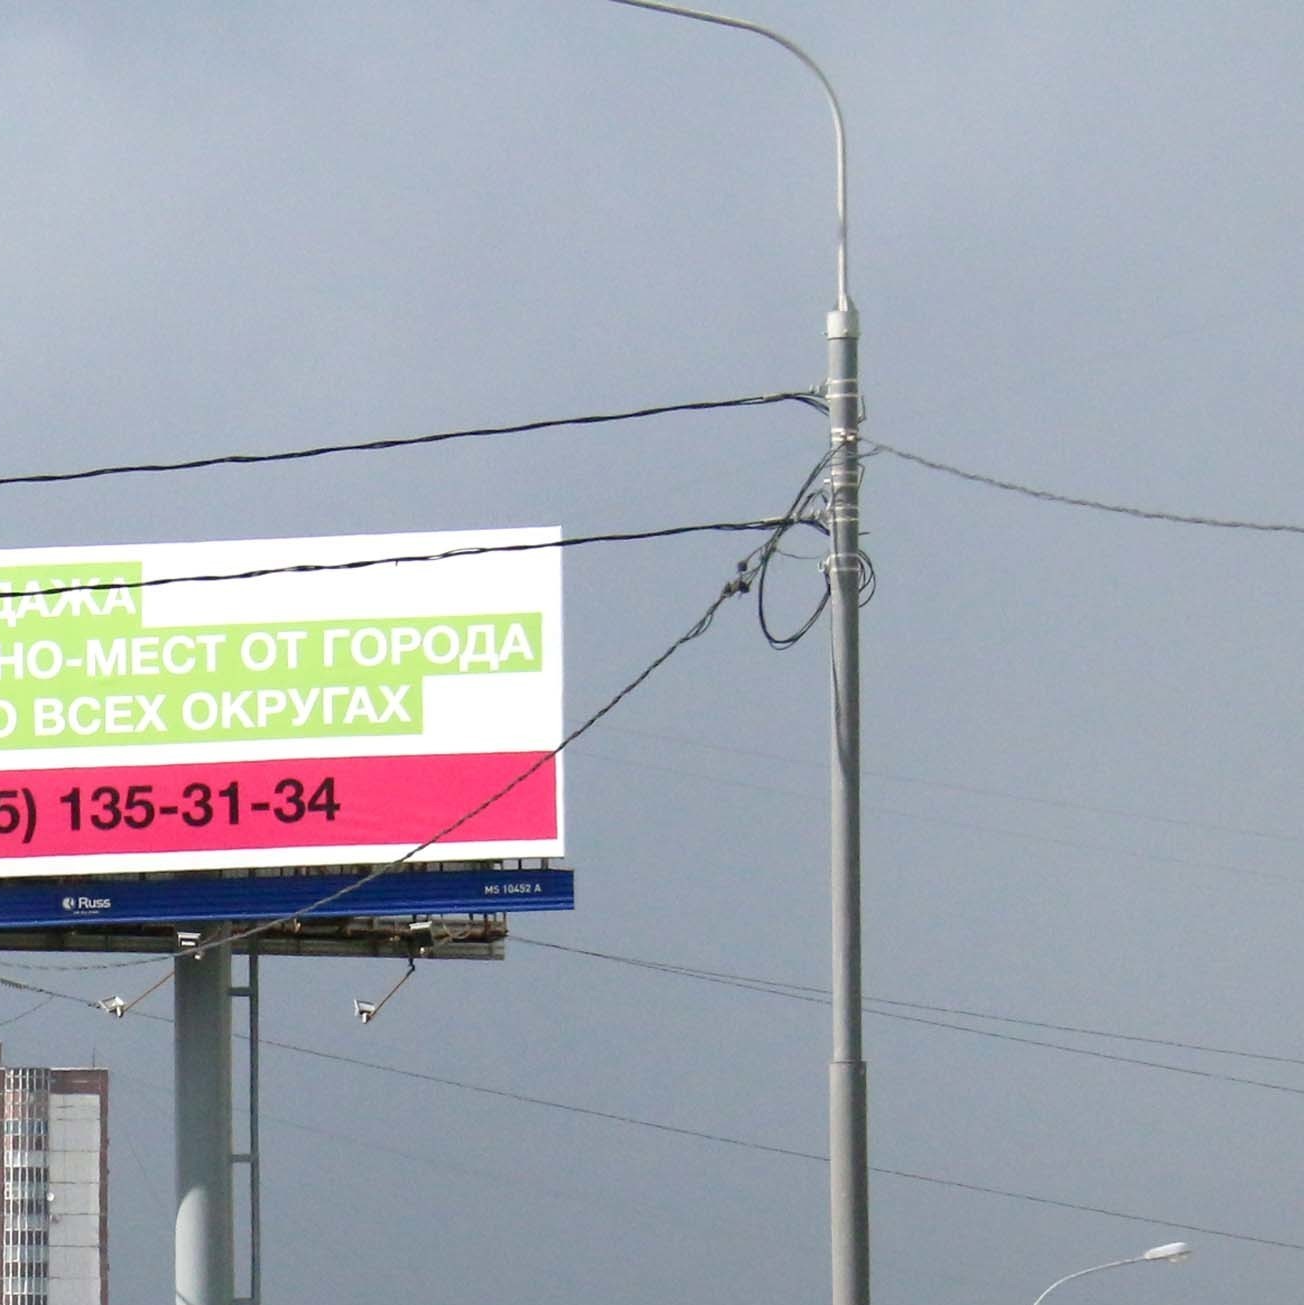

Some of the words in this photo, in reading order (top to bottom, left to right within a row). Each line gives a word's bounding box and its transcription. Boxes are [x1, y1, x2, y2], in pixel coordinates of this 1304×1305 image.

[240, 631, 308, 671] ОТ
[323, 623, 535, 672] ГОРОДА
[34, 694, 168, 737] ВСЕХ
[182, 685, 411, 731] ОКРУГАХ
[59, 777, 341, 831] 135-31-34
[78, 896, 111, 909] Russ
[484, 884, 500, 895] MS
[503, 883, 531, 894] 10452
[534, 883, 542, 893] A
